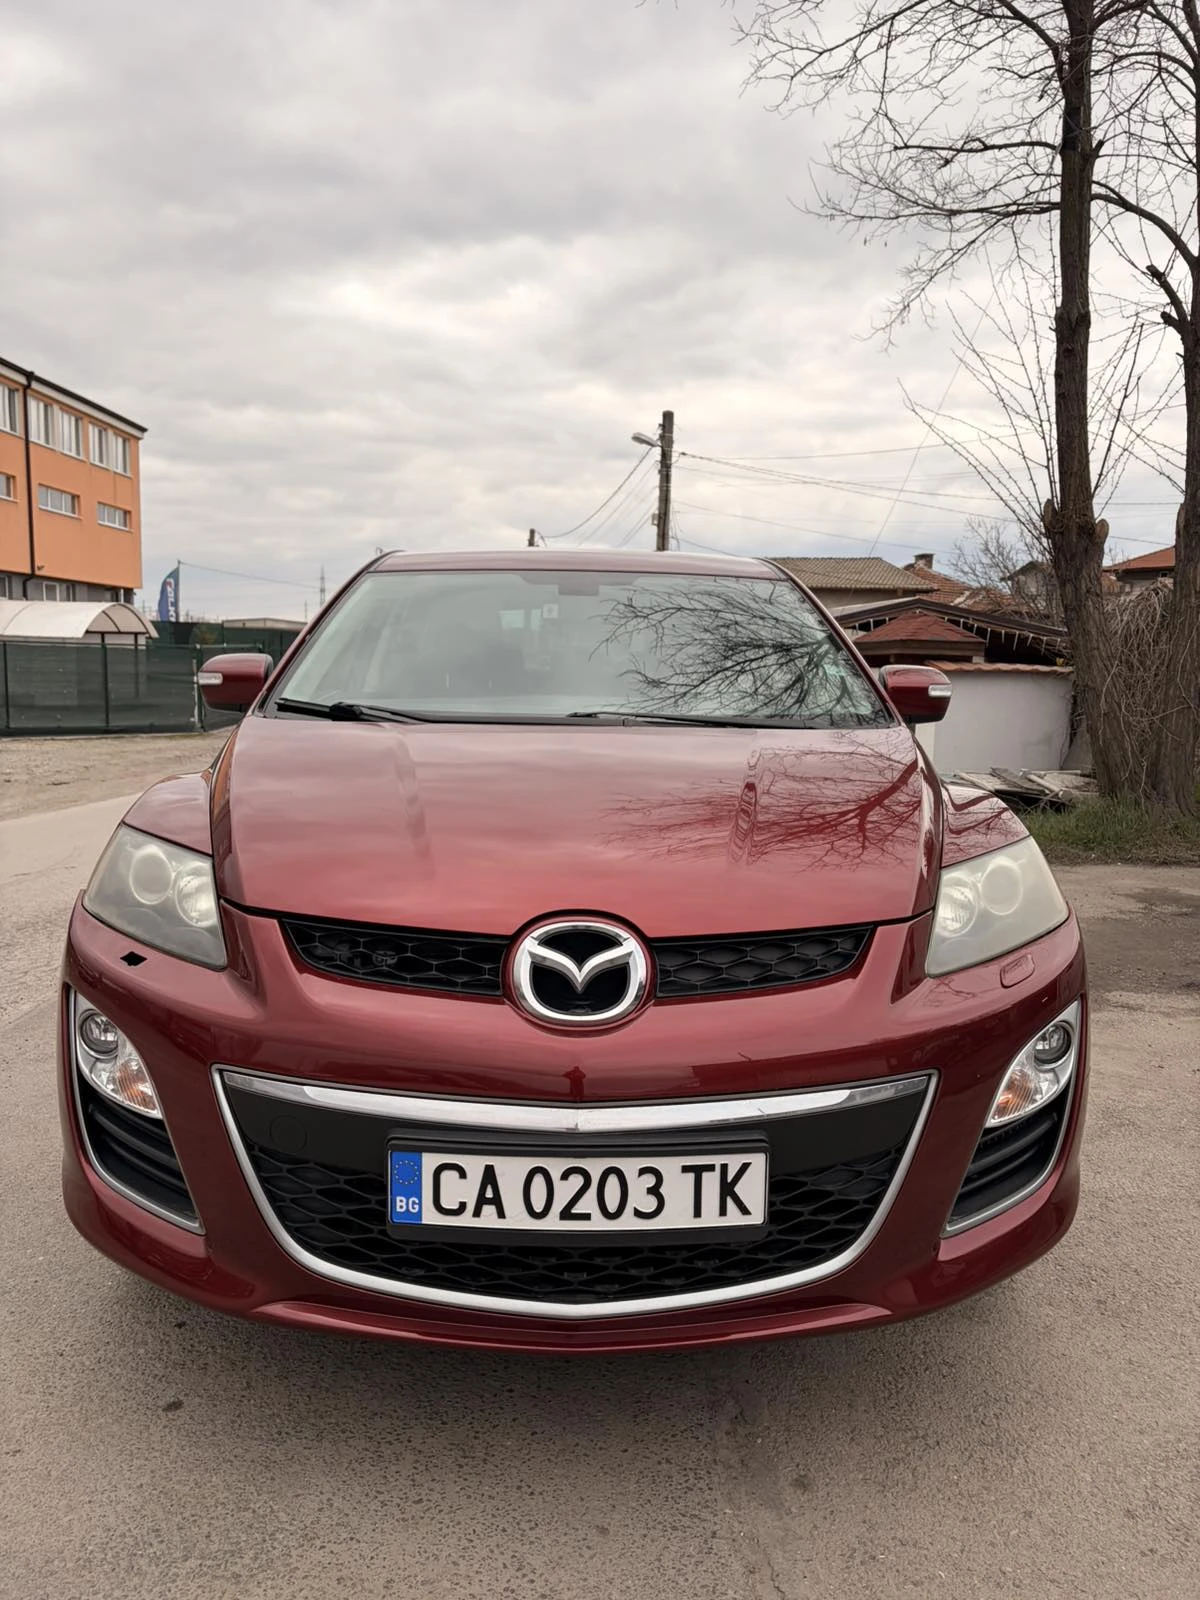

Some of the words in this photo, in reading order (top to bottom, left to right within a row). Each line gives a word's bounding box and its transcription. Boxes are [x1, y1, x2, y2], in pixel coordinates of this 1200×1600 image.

[395, 1196, 420, 1213] BG
[432, 1162, 506, 1219] CA
[522, 1166, 665, 1221] 0203
[681, 1161, 753, 1218] TK
